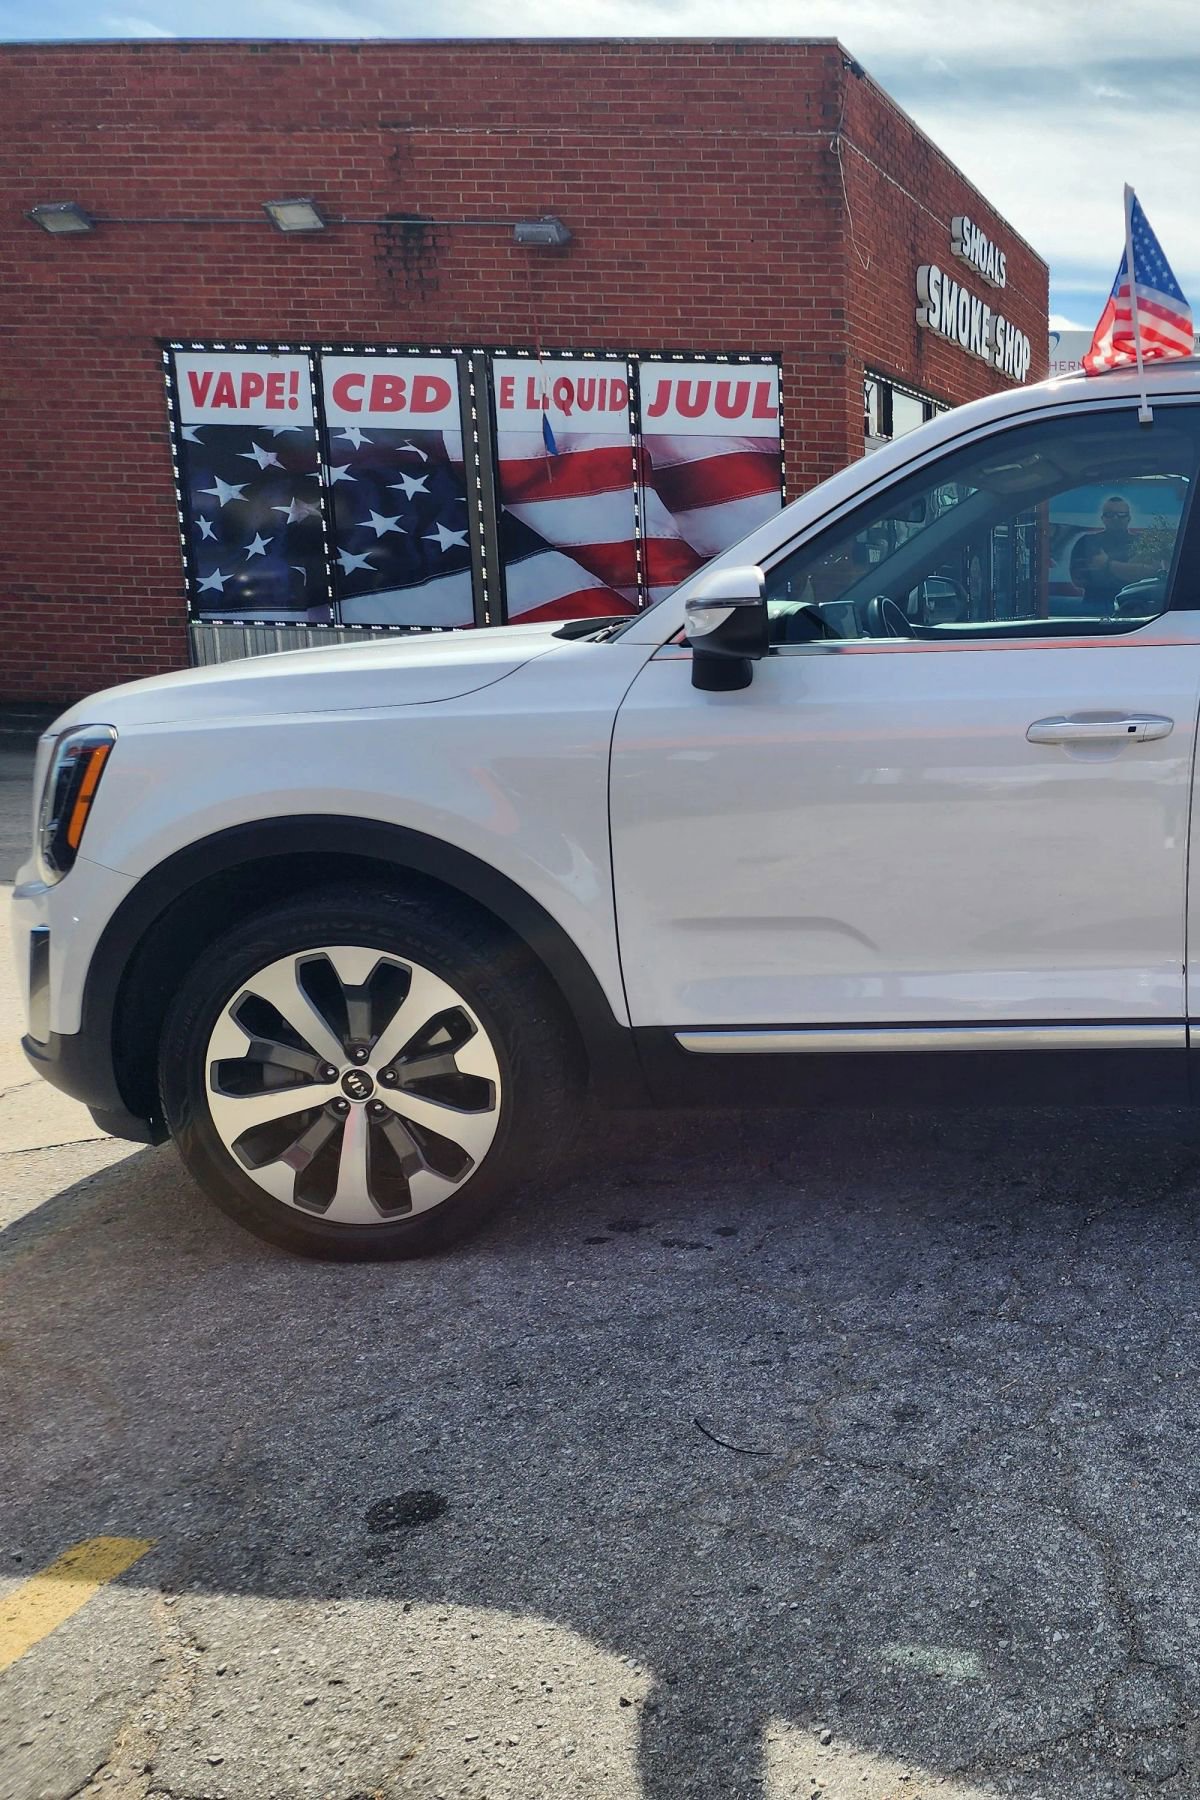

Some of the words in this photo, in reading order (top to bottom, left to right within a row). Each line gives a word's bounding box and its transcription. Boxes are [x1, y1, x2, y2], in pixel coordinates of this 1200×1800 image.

[960, 215, 1006, 288] SHOALS
[926, 264, 991, 360] SMOKE
[994, 314, 1031, 383] SHOP
[187, 371, 300, 411] VAPE!
[332, 373, 452, 413] CBD
[499, 376, 515, 409] E
[647, 379, 779, 419] JUUL
